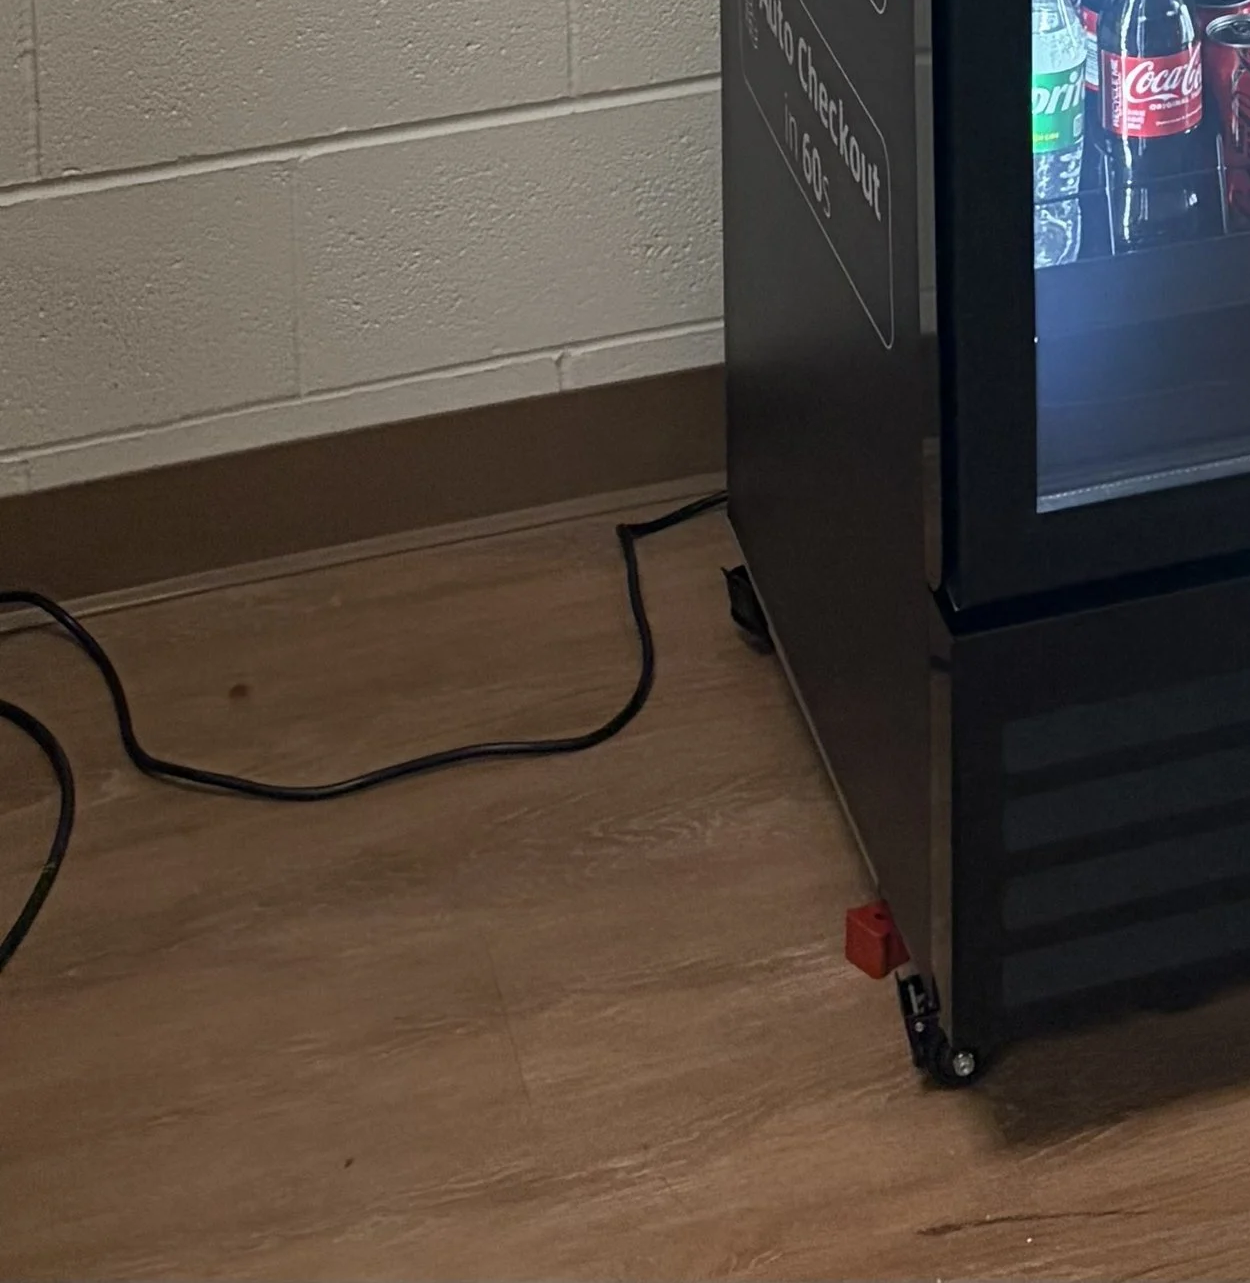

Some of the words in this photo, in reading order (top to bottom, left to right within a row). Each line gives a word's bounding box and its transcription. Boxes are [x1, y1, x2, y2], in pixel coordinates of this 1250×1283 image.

[784, 91, 798, 162] in
[802, 132, 831, 219] 60s
[798, 37, 882, 222] Checkout
